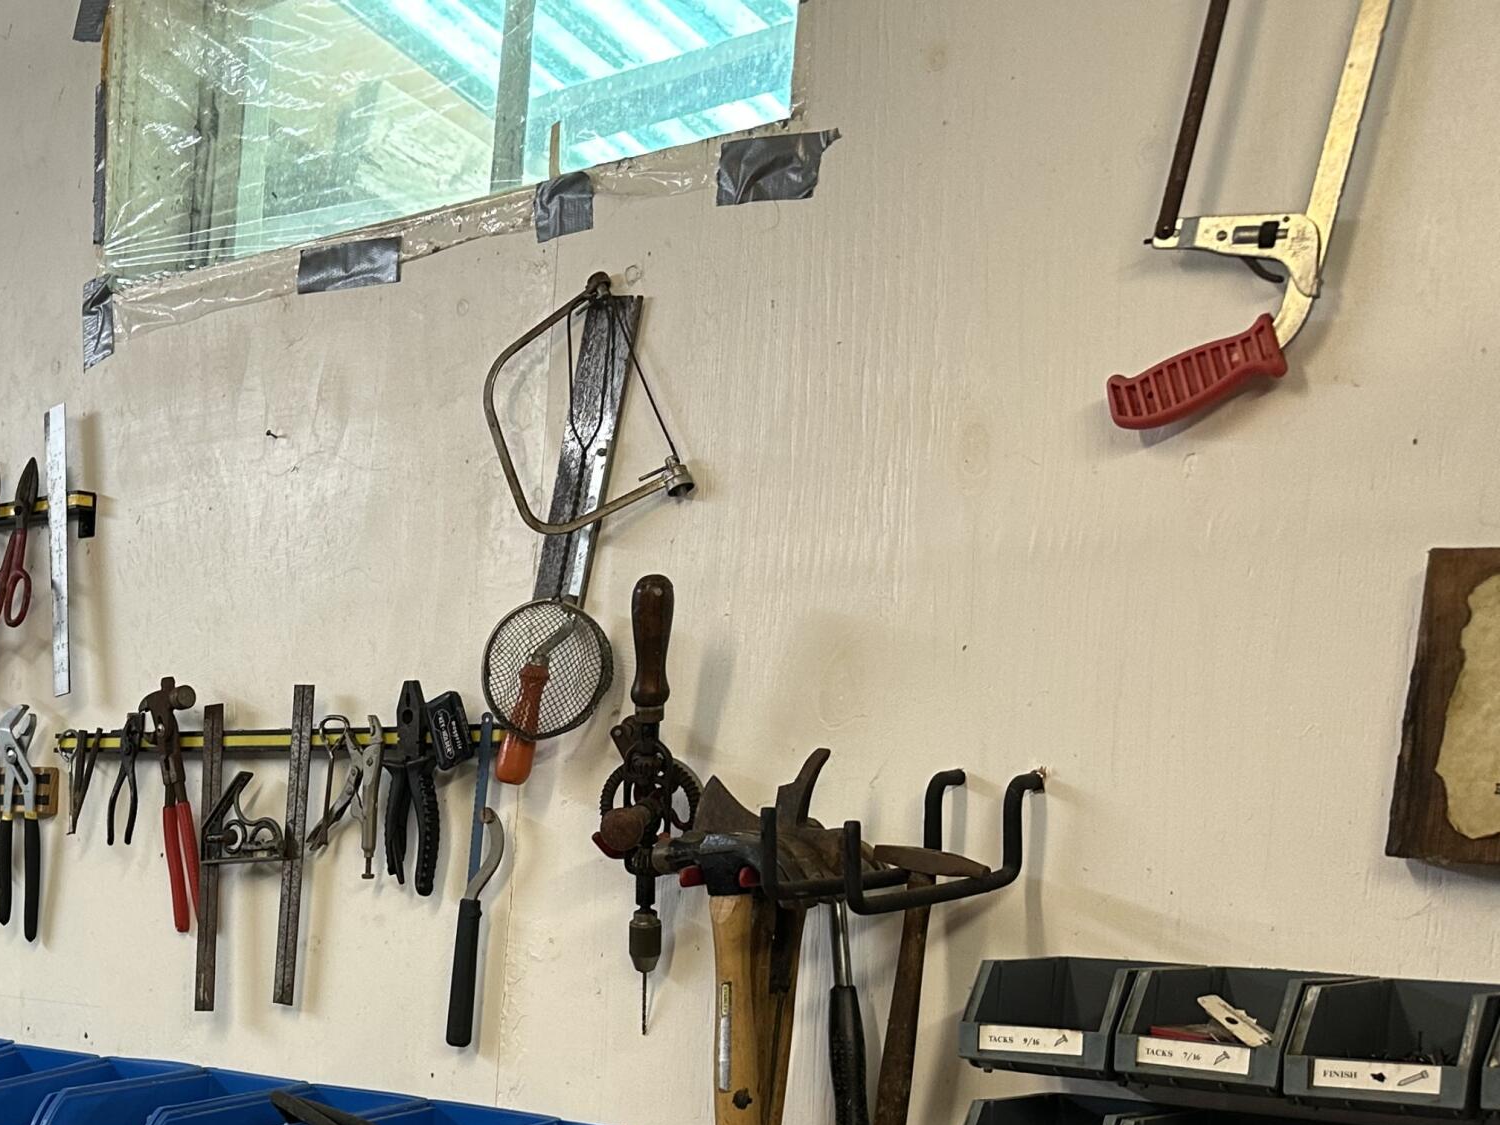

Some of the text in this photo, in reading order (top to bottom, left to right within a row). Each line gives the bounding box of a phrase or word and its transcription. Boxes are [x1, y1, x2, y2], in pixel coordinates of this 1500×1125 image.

[988, 1034, 1041, 1046] TACKS 9/16
[1145, 1047, 1201, 1061] TACKS 7/16
[1322, 1069, 1358, 1079] FINISH
